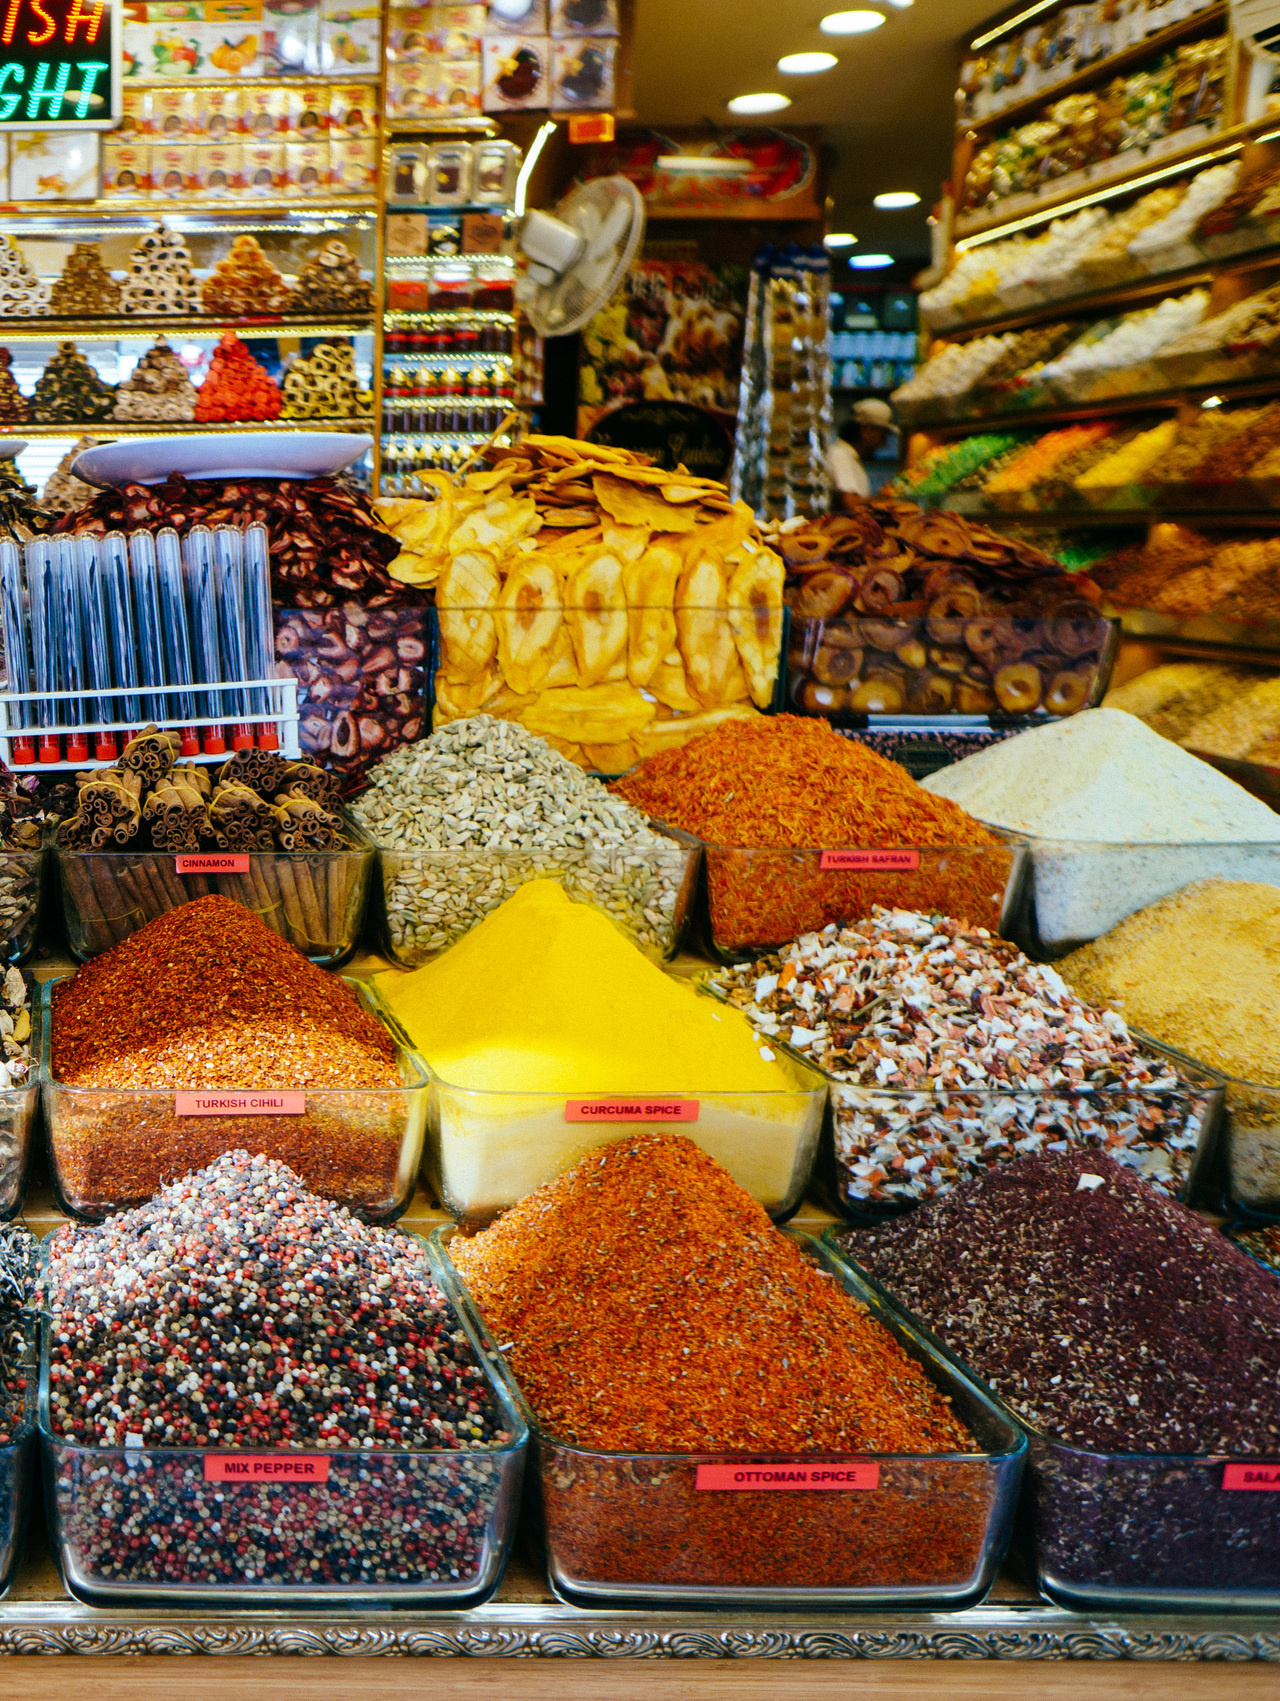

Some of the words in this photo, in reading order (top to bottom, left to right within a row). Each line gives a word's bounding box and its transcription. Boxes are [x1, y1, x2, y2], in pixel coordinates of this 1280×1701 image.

[182, 859, 235, 868] CINNAMON
[826, 855, 870, 864] TURKISH
[871, 855, 912, 864] SAFRAN
[195, 1099, 247, 1109] TURKISH
[250, 1098, 284, 1108] CIHILI
[581, 1105, 642, 1115] CURCUMA
[644, 1105, 682, 1115] SPICE
[224, 1462, 250, 1474] MIX
[253, 1463, 316, 1474] PEPPER
[734, 1471, 807, 1482] OTTOMAN
[810, 1470, 857, 1482] SPICE
